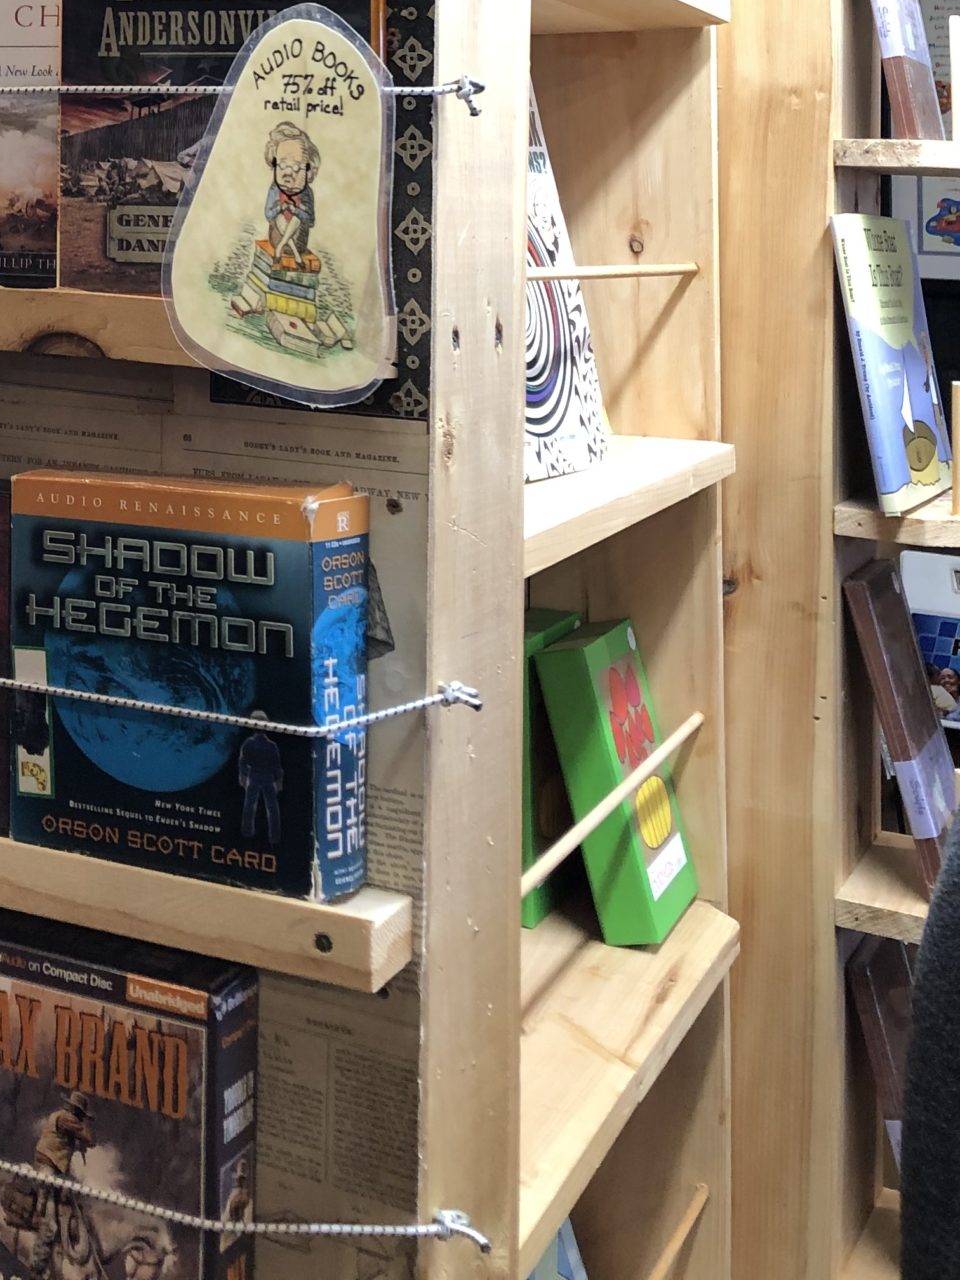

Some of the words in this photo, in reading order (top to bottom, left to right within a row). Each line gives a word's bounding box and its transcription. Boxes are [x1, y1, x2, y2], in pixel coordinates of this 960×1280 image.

[3, 65, 26, 78] New
[29, 64, 53, 78] Look
[252, 38, 303, 91] AUDIO
[311, 40, 366, 101] BOOKS
[281, 74, 315, 96] 75%
[316, 76, 338, 97] off
[263, 97, 301, 113] retail
[305, 95, 344, 119] price!
[35, 491, 104, 509] AUDIO
[119, 498, 283, 525] RENAISSANCE
[42, 528, 276, 587] SHADOW
[322, 551, 365, 571] ORSON
[95, 575, 139, 599] OF
[149, 581, 218, 611] THE
[323, 570, 364, 591] SCOTT
[25, 592, 295, 659] HEGEMON
[42, 815, 120, 845] ORSON
[127, 830, 204, 860] SCOTT
[210, 845, 277, 873] CARD
[28, 960, 41, 973] on
[41, 961, 89, 984] Compact
[90, 973, 113, 992] Disc
[128, 982, 207, 1015] Unabridged
[53, 1004, 189, 1120] BRAND
